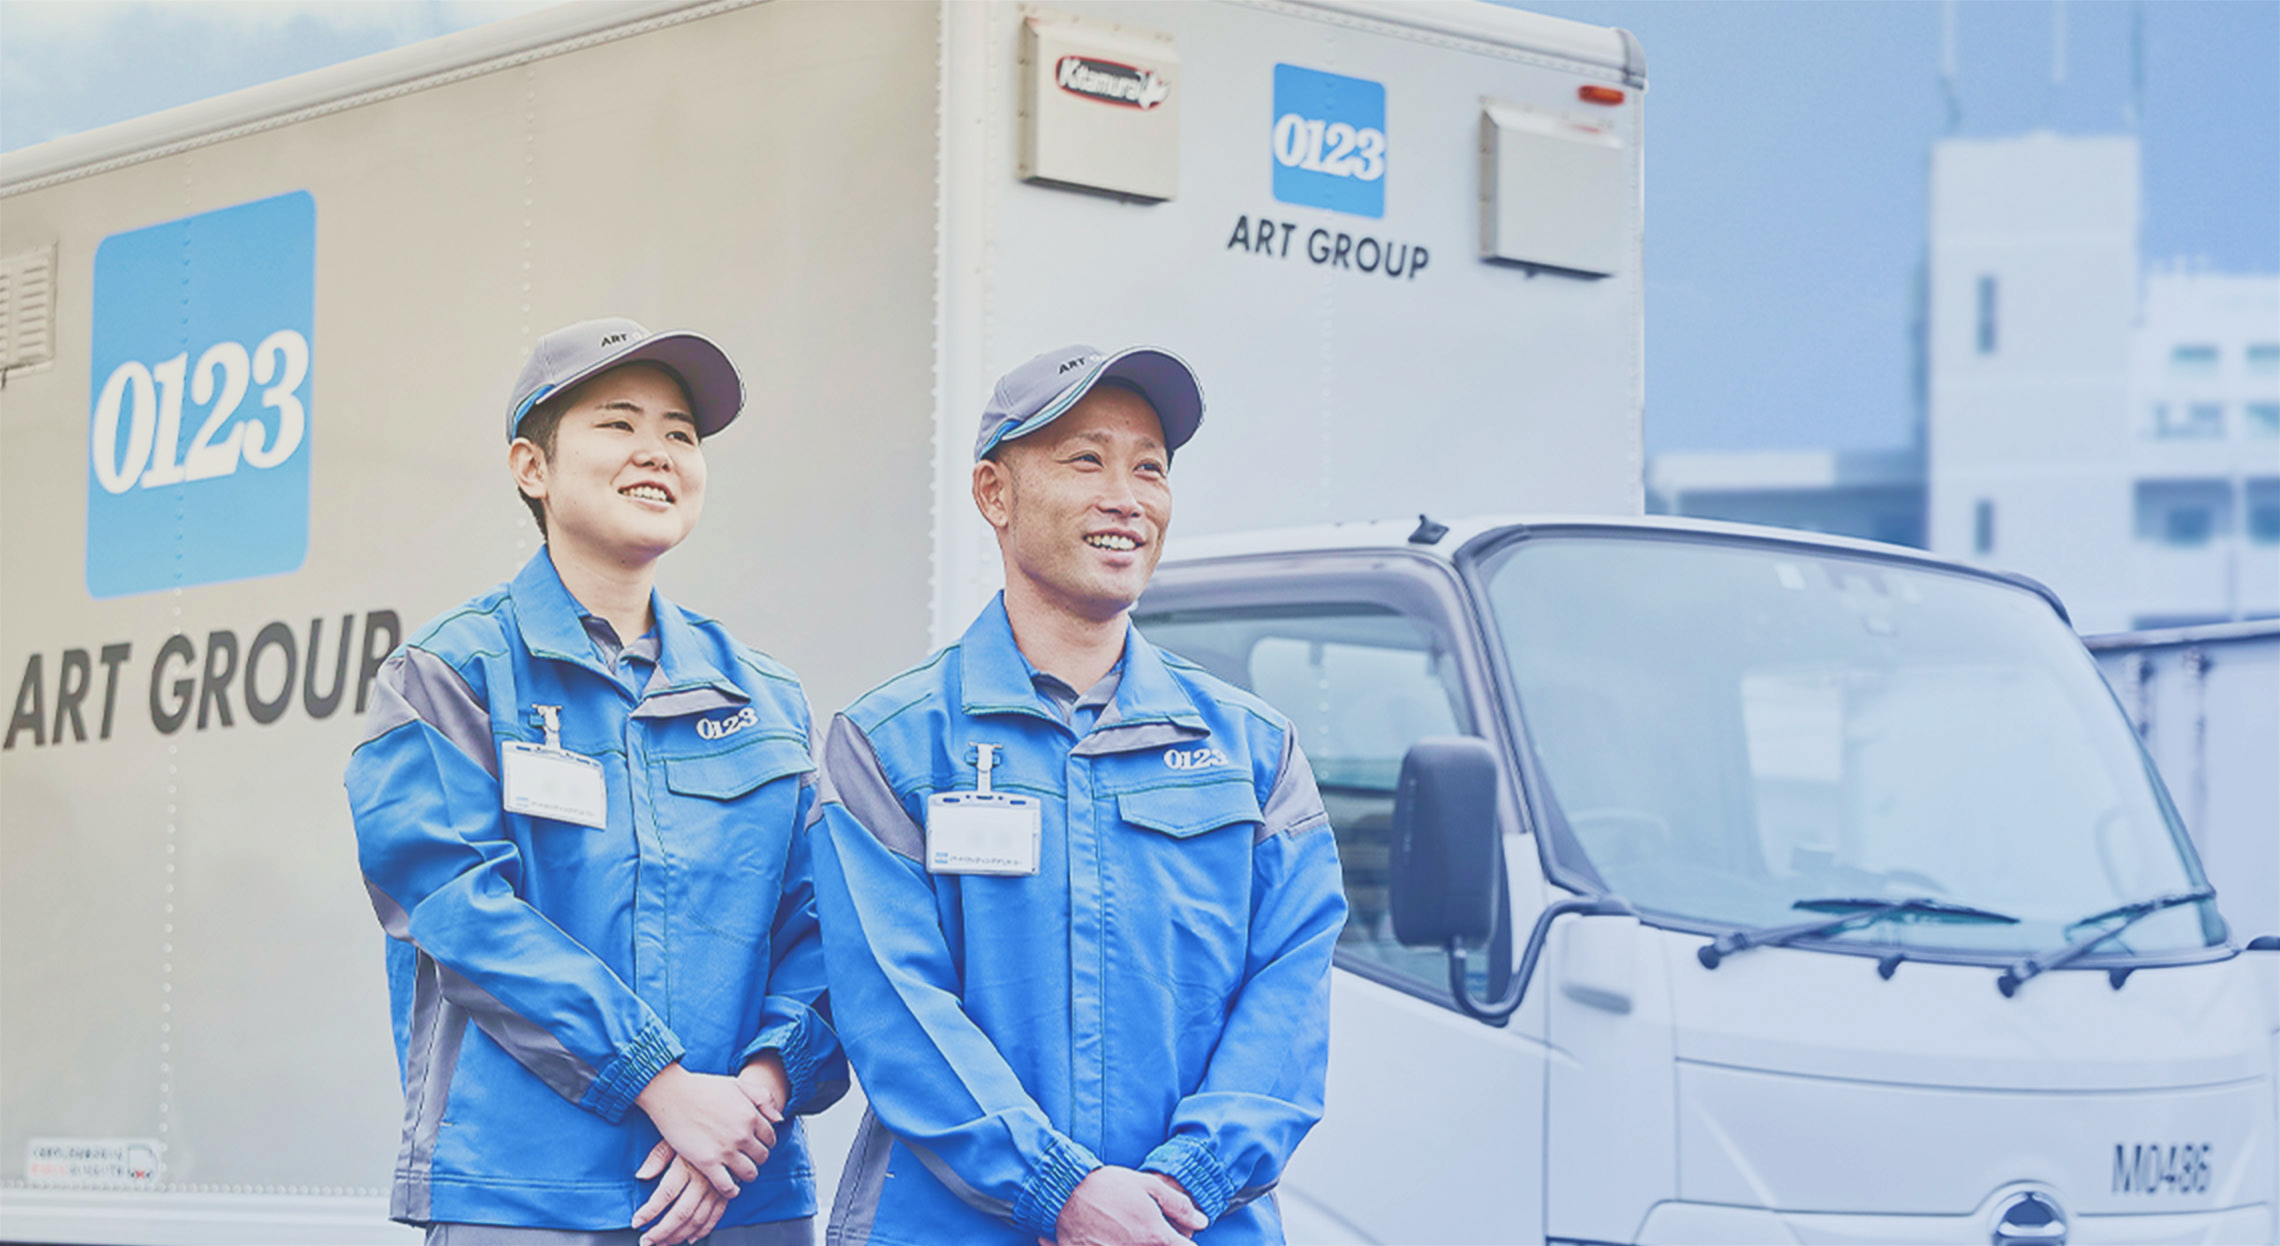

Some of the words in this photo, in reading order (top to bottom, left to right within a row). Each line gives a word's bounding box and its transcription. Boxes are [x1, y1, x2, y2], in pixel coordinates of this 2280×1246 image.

[1273, 112, 1387, 182] 0123
[1227, 214, 1298, 259] ART
[1307, 227, 1430, 280] GROUP
[91, 328, 310, 495] 0123
[2, 640, 133, 751] ART
[148, 608, 401, 735] GROUP
[695, 706, 760, 741] 0123
[1163, 748, 1230, 771] 0123
[2110, 1142, 2213, 1194] M0486
